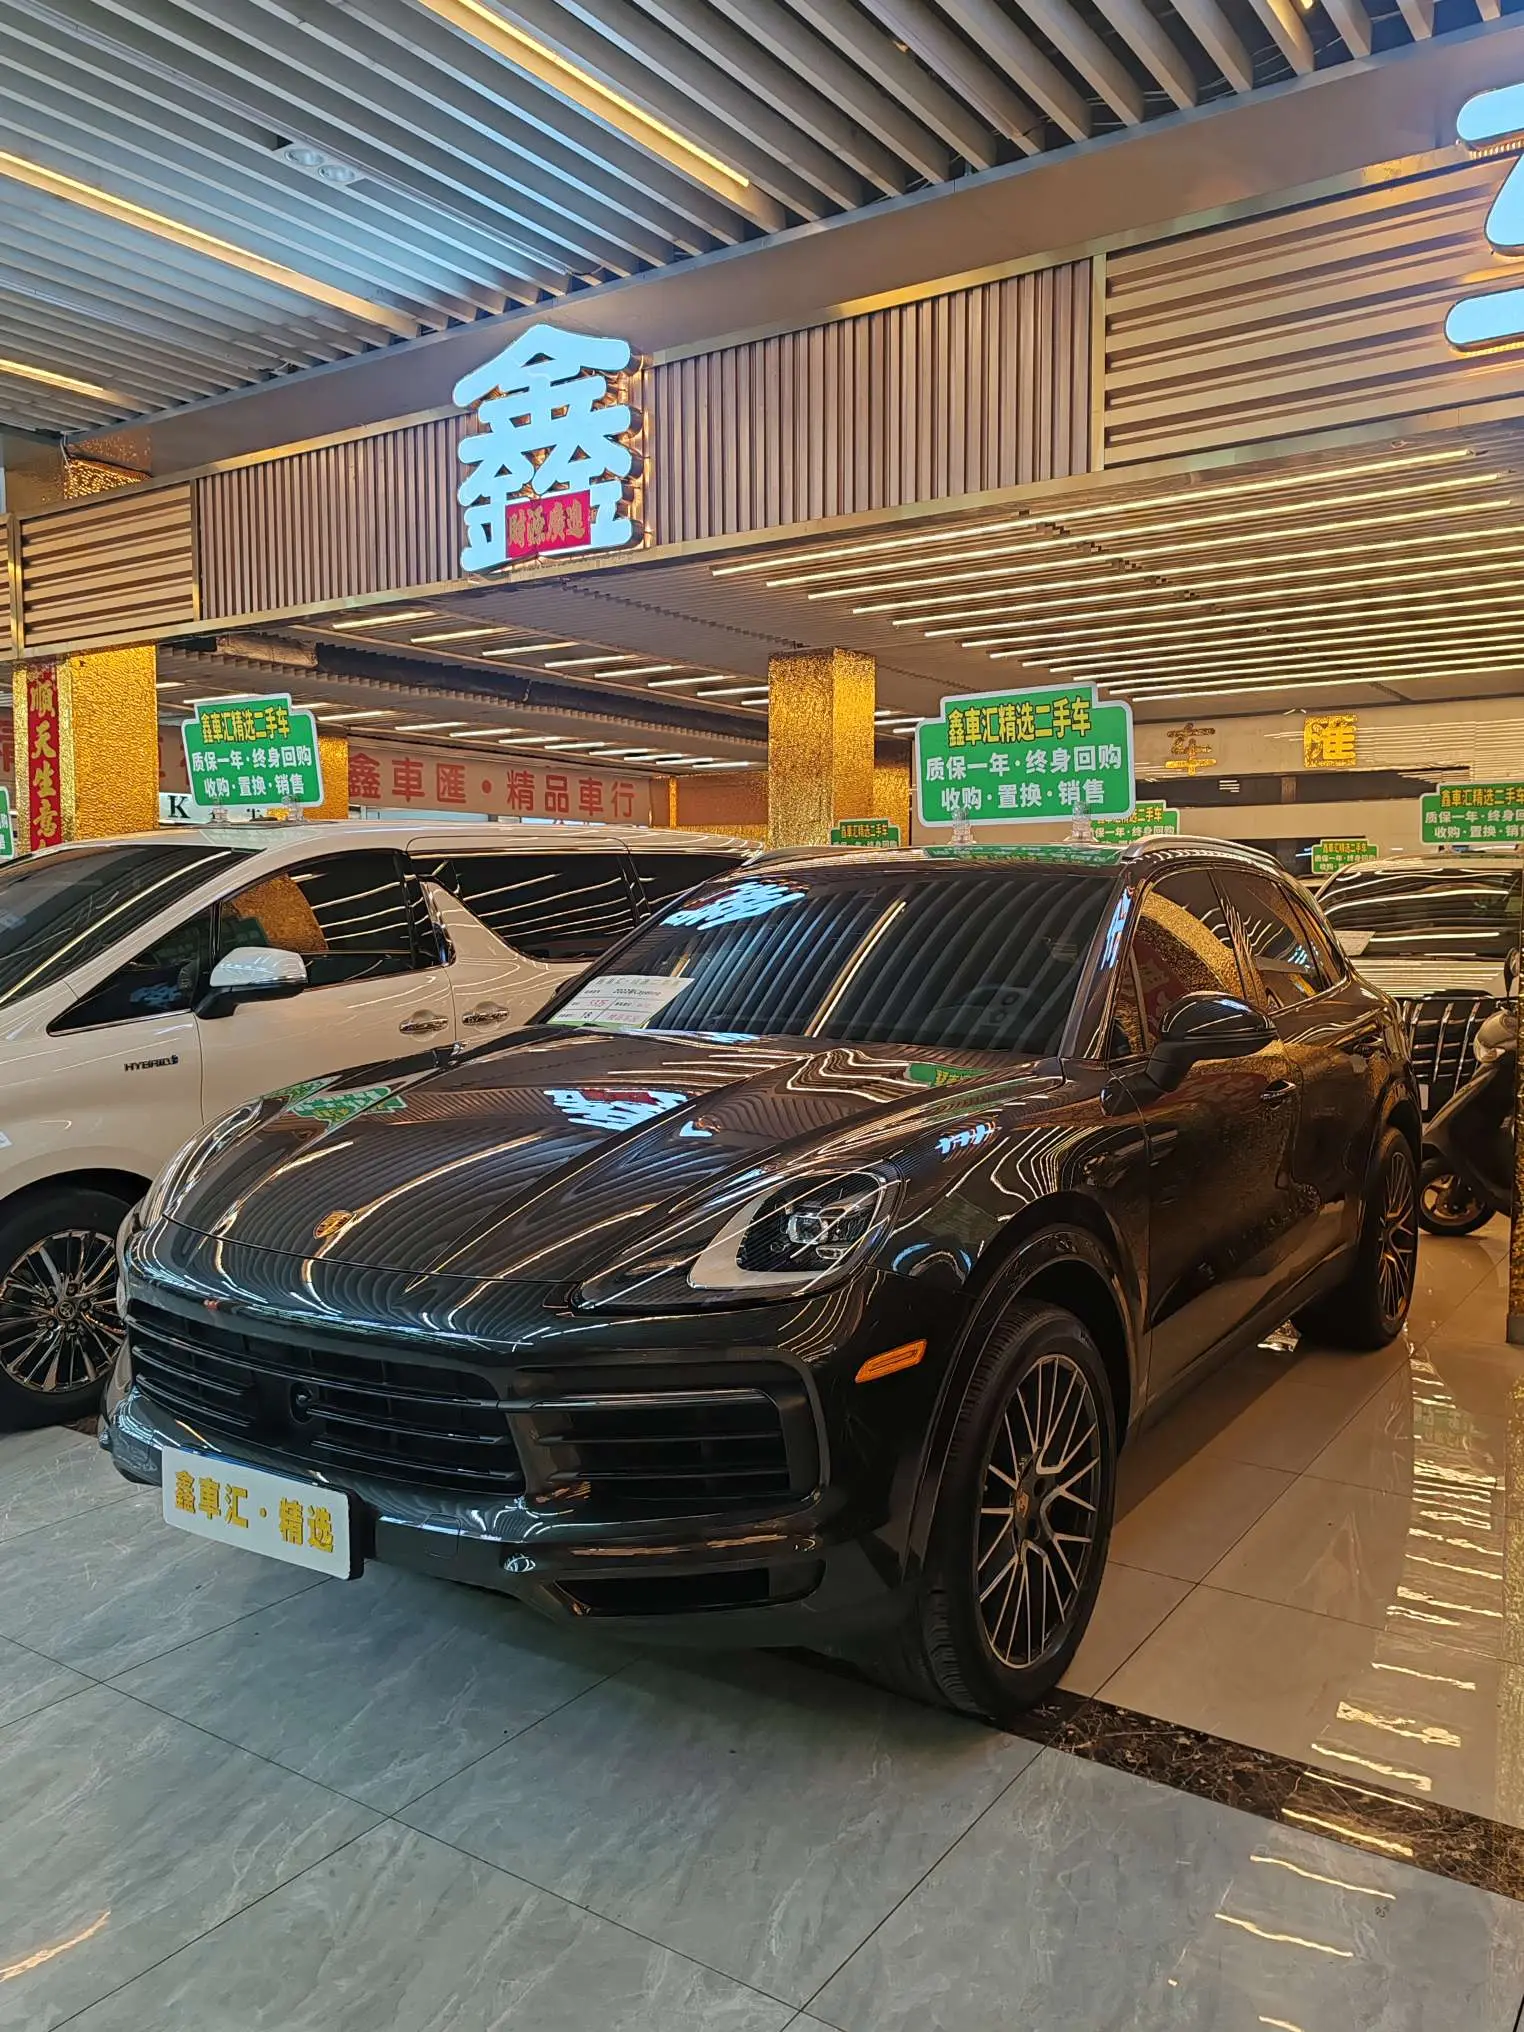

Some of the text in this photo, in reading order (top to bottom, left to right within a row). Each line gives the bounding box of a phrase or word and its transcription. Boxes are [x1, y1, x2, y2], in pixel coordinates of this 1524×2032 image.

[453, 324, 634, 571] 鑫
[201, 706, 290, 744] 鑫車汇精选二手车
[948, 696, 1091, 748] 鑫車汇精选二手车
[191, 745, 312, 772] 质保一年·终身回购
[926, 743, 1122, 781] 质保一年·终身回购
[204, 773, 304, 797] 收购·置换·销售
[941, 778, 1105, 811] 收购·置换·销售
[124, 1057, 171, 1072] HYBRID
[175, 1470, 334, 1553] 鑫車汇·精选
